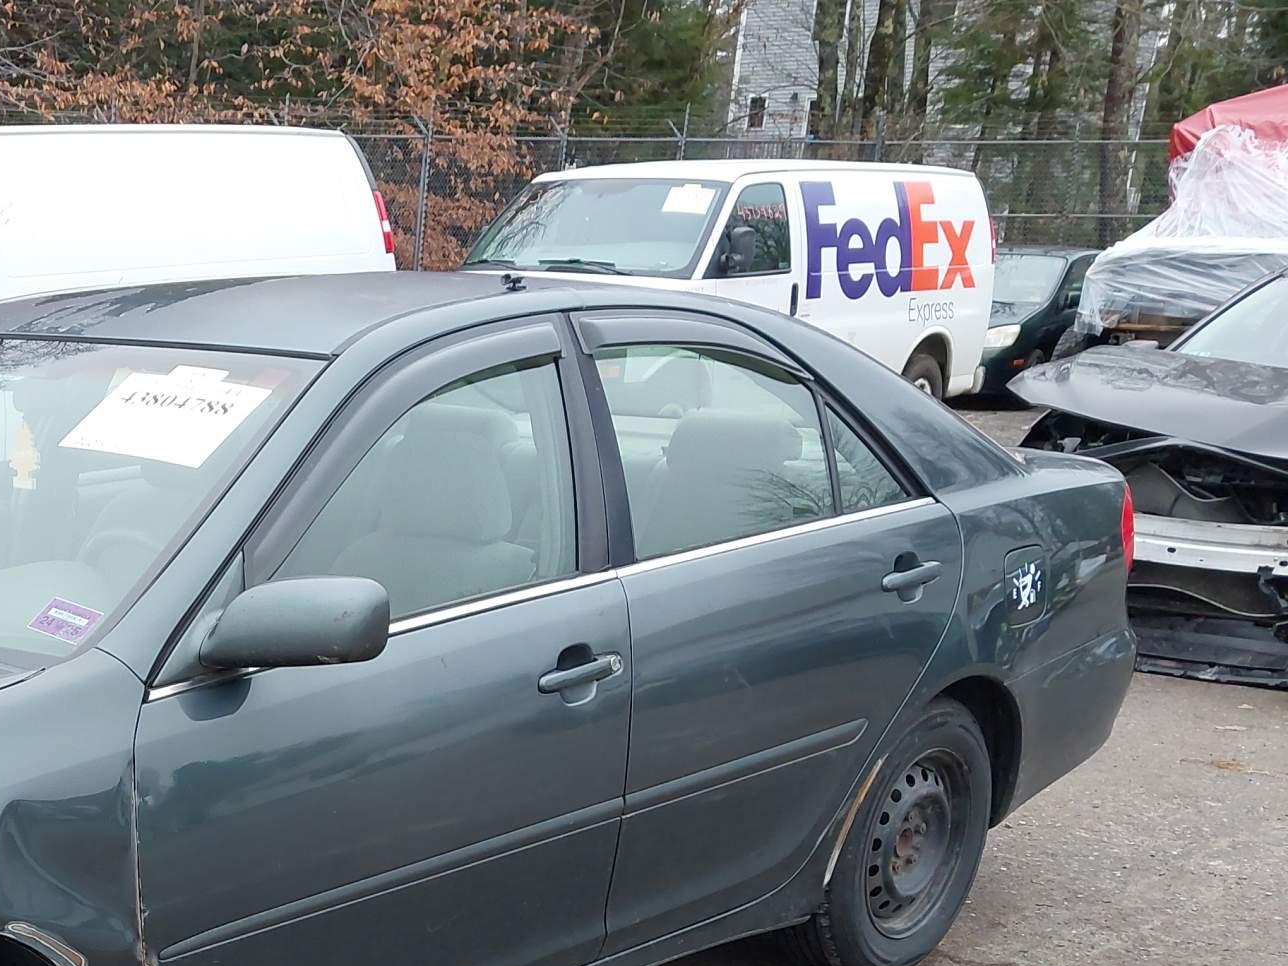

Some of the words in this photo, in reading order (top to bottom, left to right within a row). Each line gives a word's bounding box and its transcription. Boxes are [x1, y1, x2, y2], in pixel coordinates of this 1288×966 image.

[798, 181, 976, 300] FedEx
[908, 298, 955, 326] Express
[121, 391, 235, 416] 43804788
